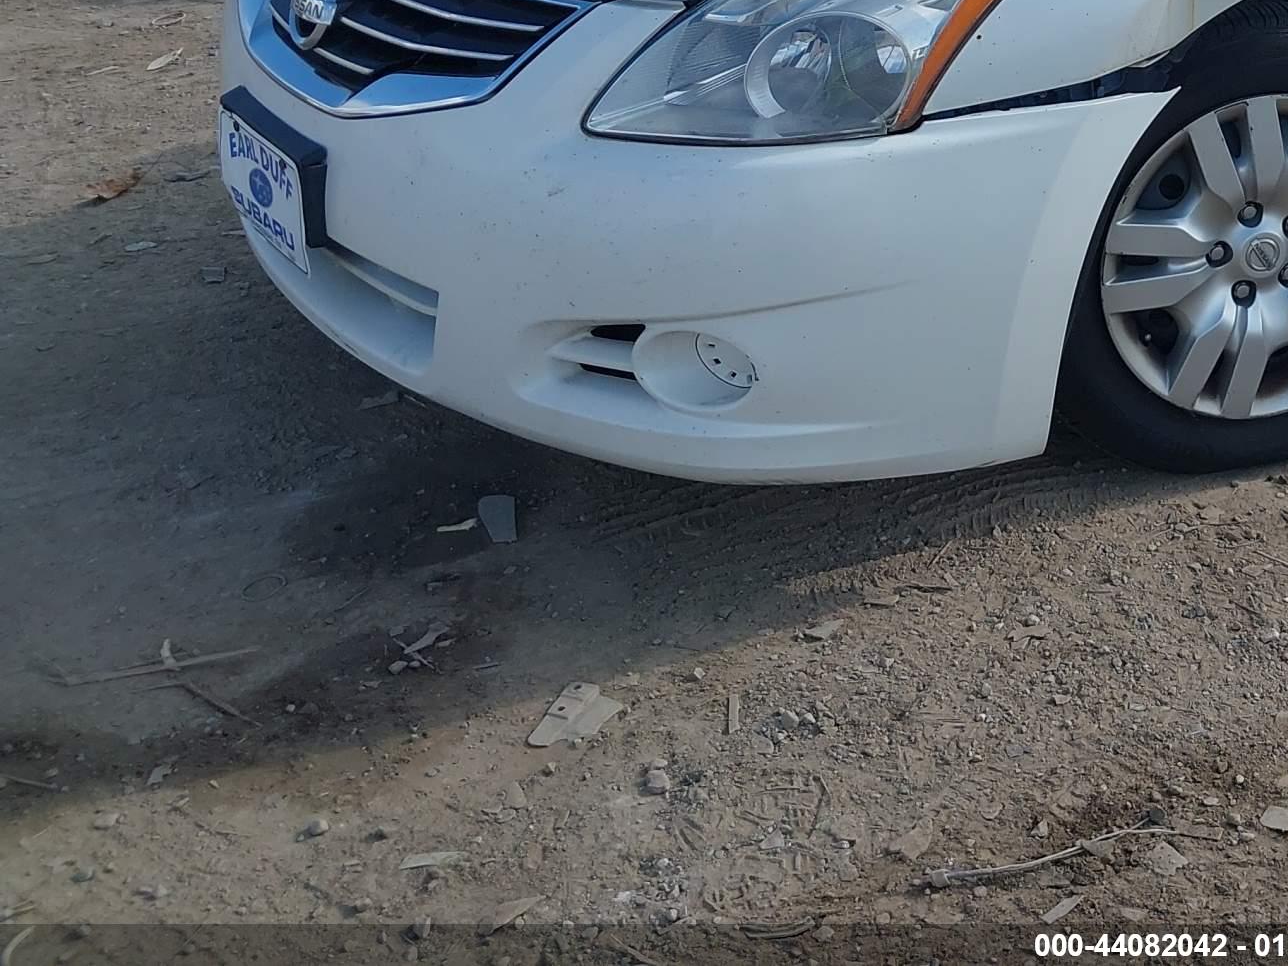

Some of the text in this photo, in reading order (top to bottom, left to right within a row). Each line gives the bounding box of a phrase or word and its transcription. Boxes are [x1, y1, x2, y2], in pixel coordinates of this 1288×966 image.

[229, 131, 294, 200] EARL DUFF
[231, 185, 296, 251] SUBARU
